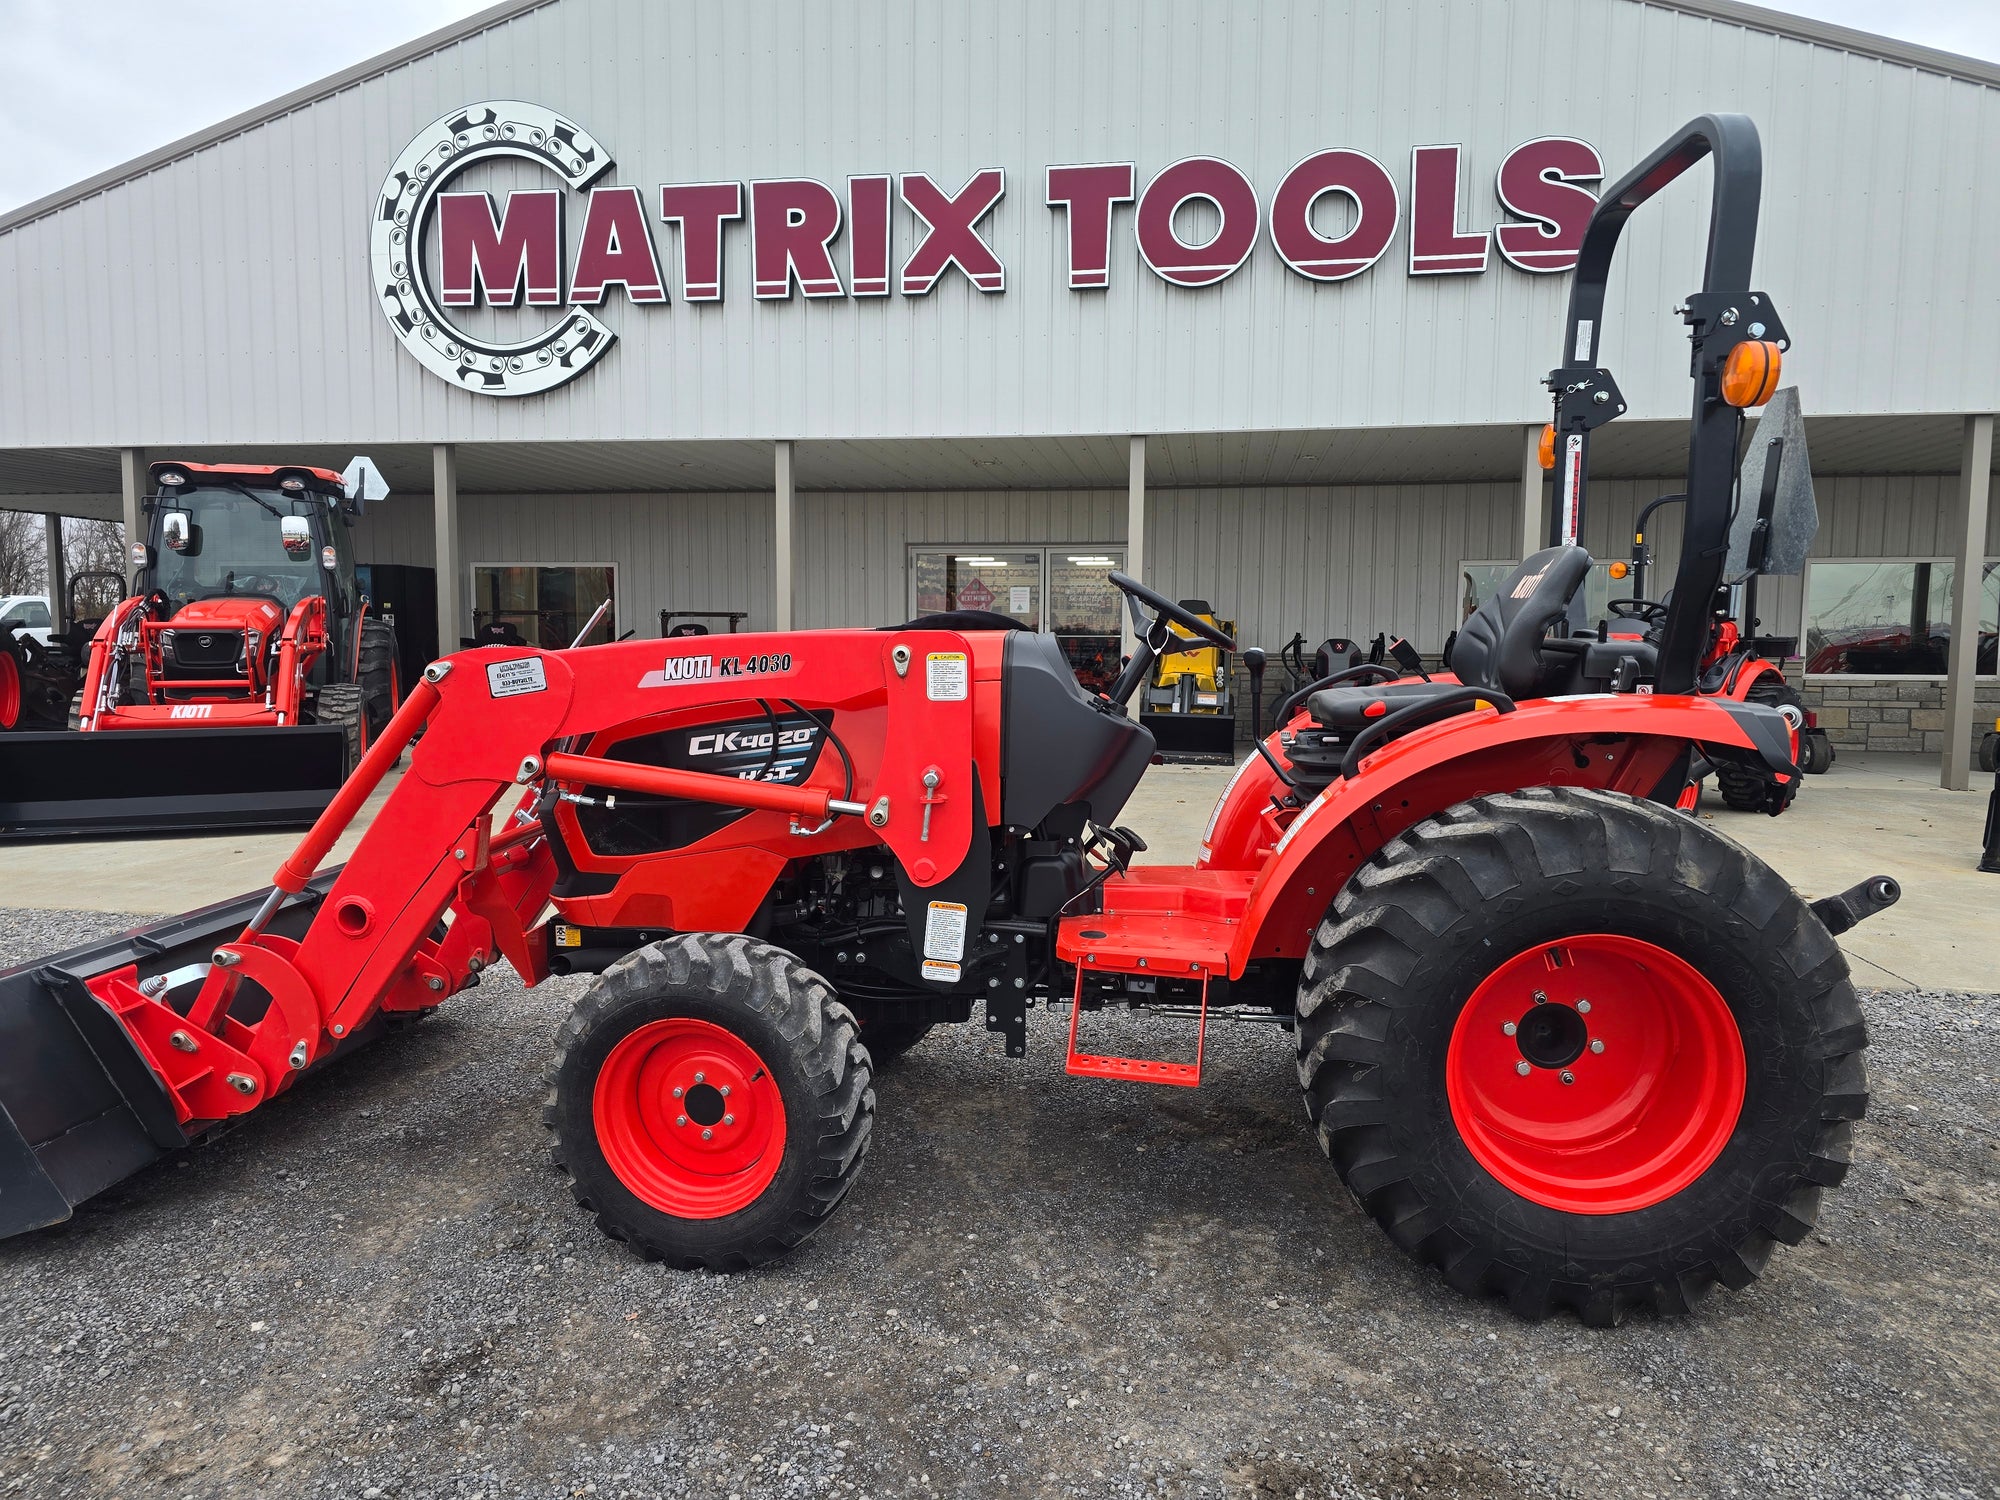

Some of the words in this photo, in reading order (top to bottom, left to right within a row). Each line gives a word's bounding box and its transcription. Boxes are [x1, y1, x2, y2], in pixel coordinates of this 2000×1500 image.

[436, 166, 1006, 308] MATRIX
[1044, 134, 1606, 290] TOOLS
[664, 654, 712, 681] KIOTI
[719, 657, 743, 677] KL
[746, 653, 792, 674] 4030
[170, 704, 213, 719] KIOTI
